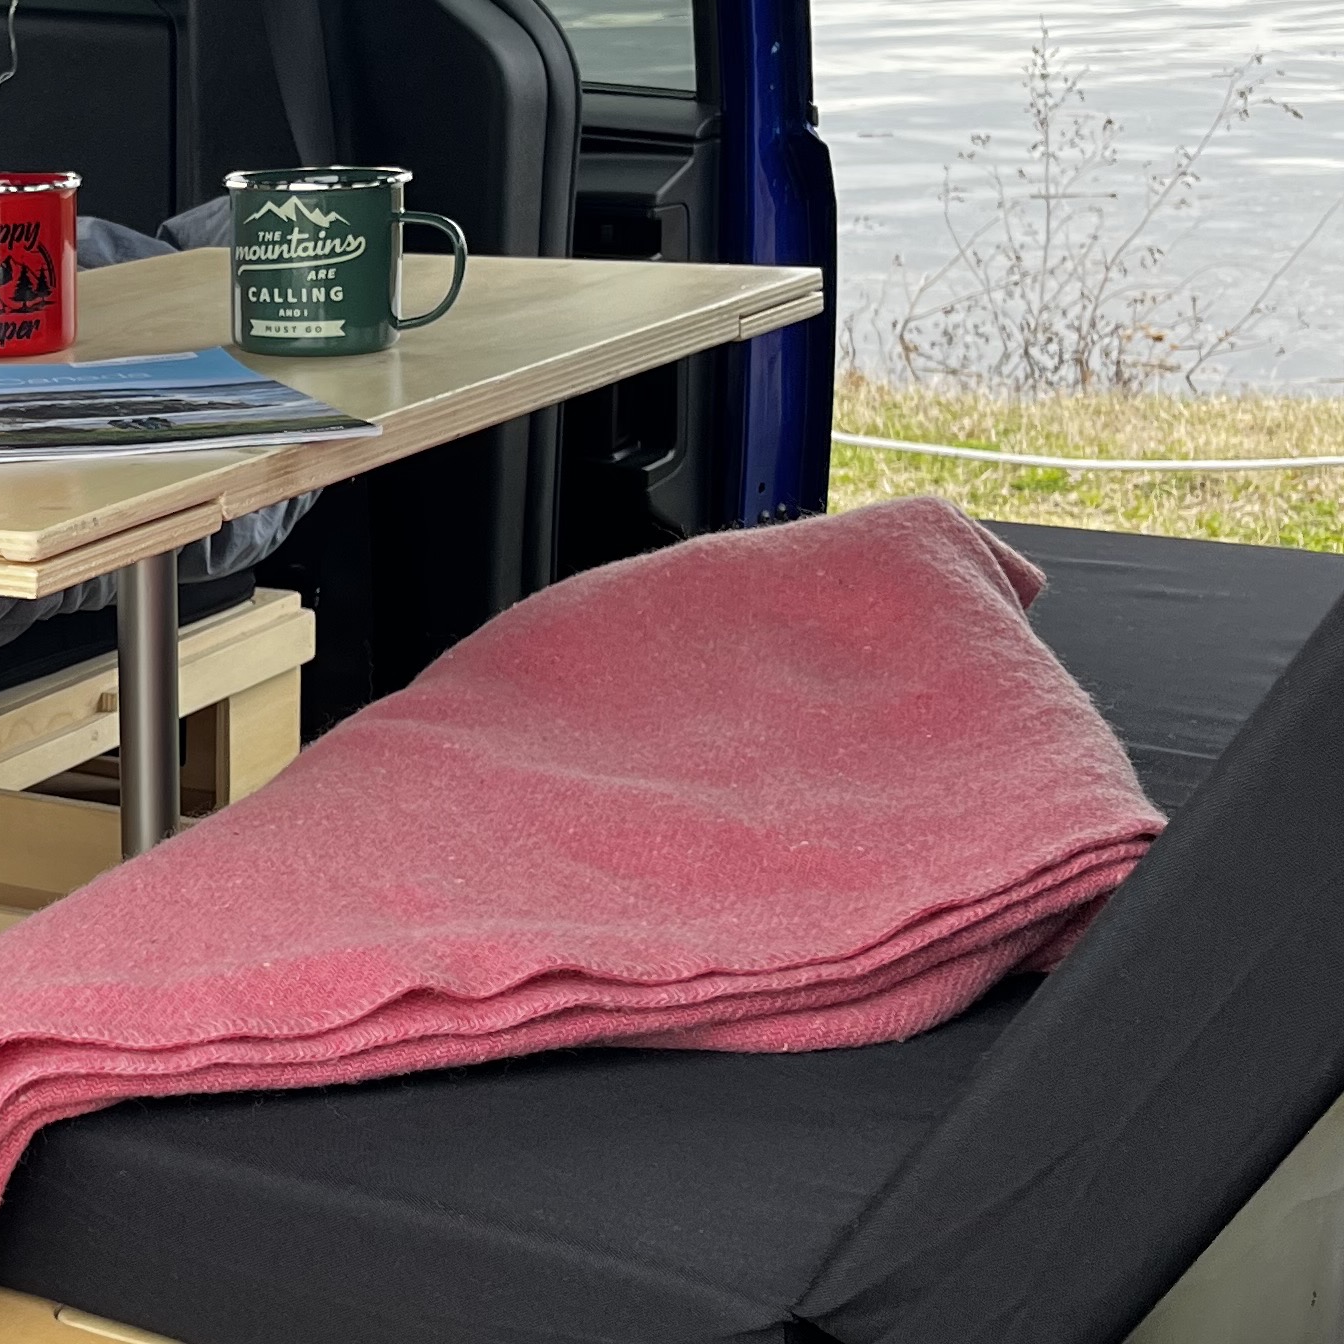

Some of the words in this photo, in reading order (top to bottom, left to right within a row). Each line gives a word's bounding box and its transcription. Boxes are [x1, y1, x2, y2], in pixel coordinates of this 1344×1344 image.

[258, 231, 282, 242] THE
[236, 227, 365, 262] mountains
[307, 268, 336, 281] ARE
[248, 287, 344, 303] CALLING
[279, 309, 301, 317] AND
[306, 325, 322, 333] GO
